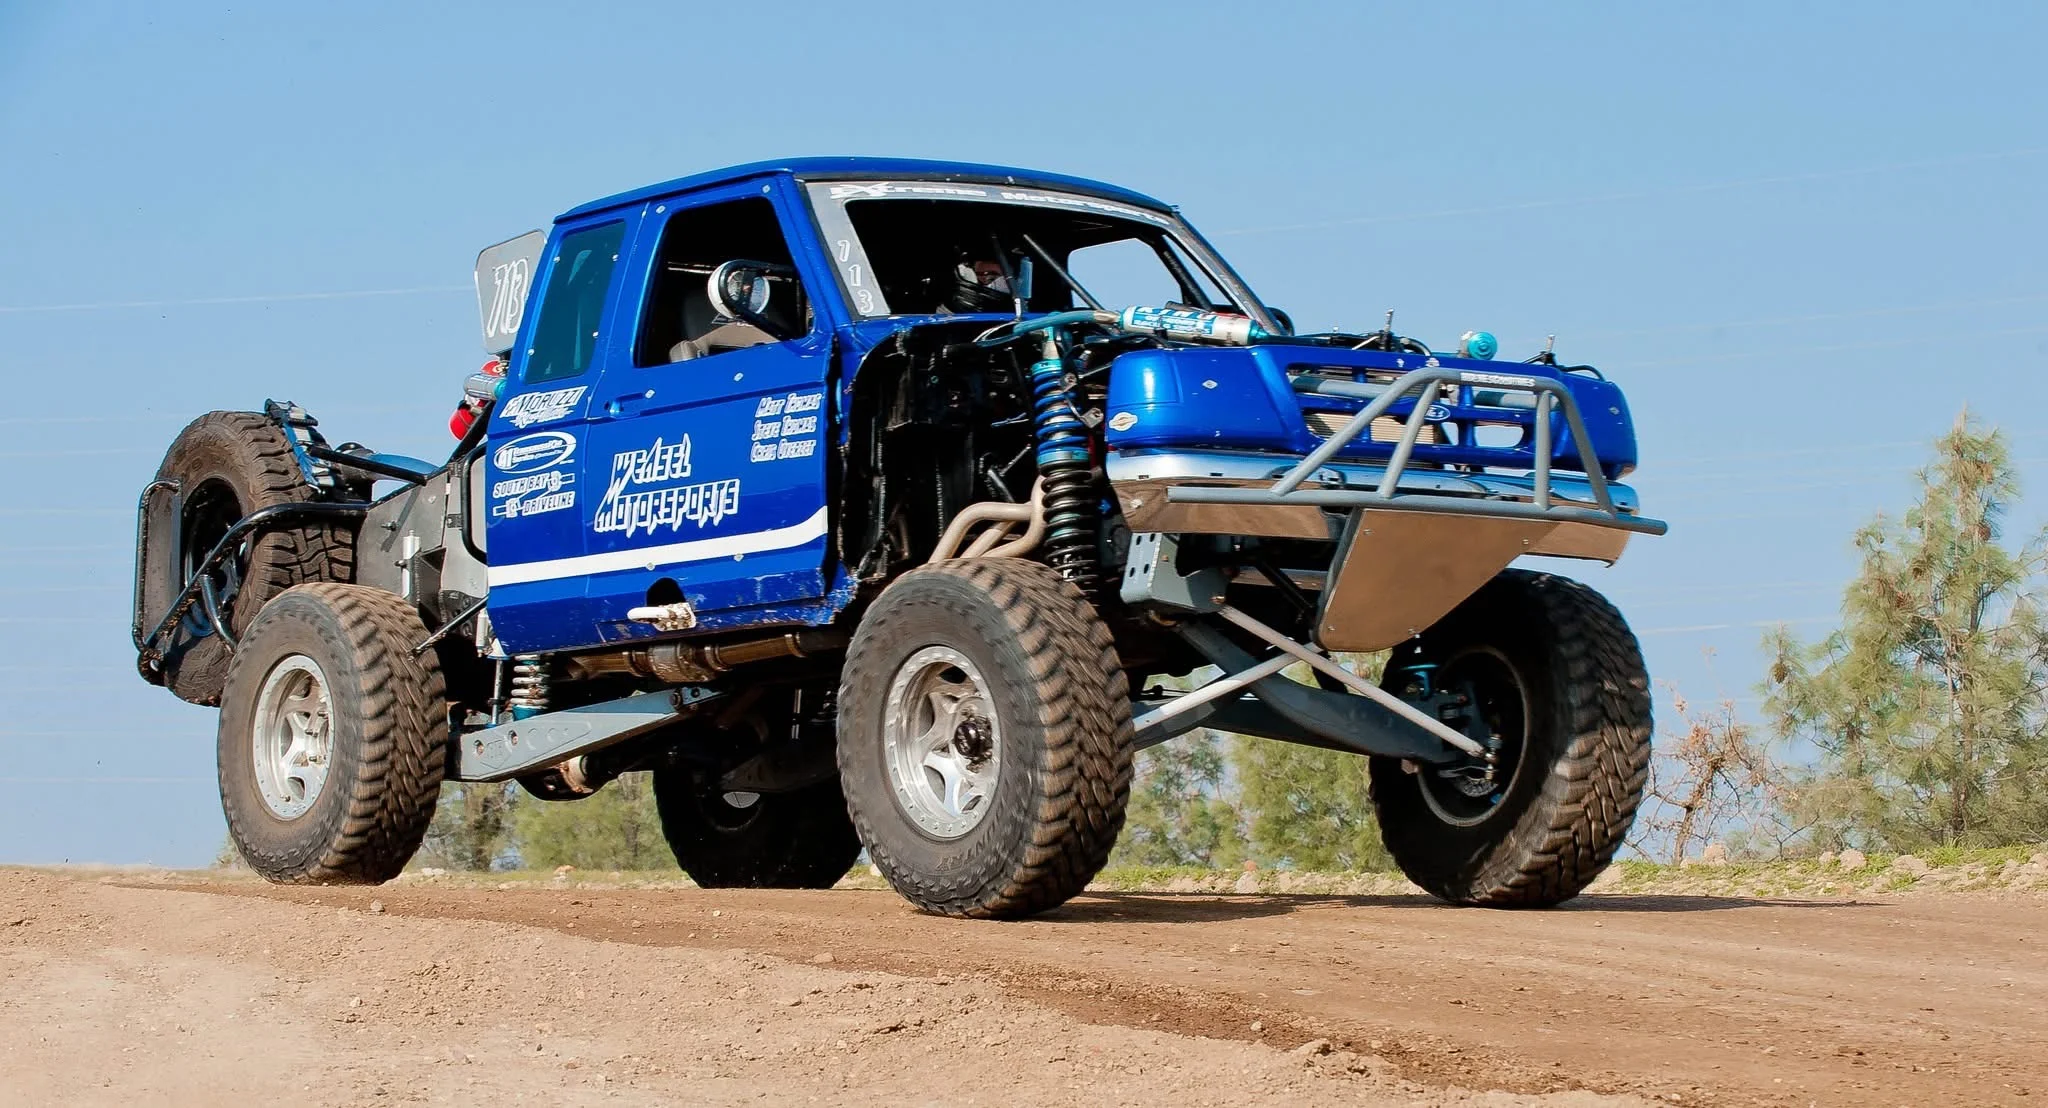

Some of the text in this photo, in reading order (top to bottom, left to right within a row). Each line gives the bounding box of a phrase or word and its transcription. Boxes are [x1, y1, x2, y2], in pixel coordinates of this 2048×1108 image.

[493, 473, 550, 498] SOUTH BAY
[522, 491, 576, 516] DRIVELINE
[594, 478, 740, 538] MOTORSPORTS
